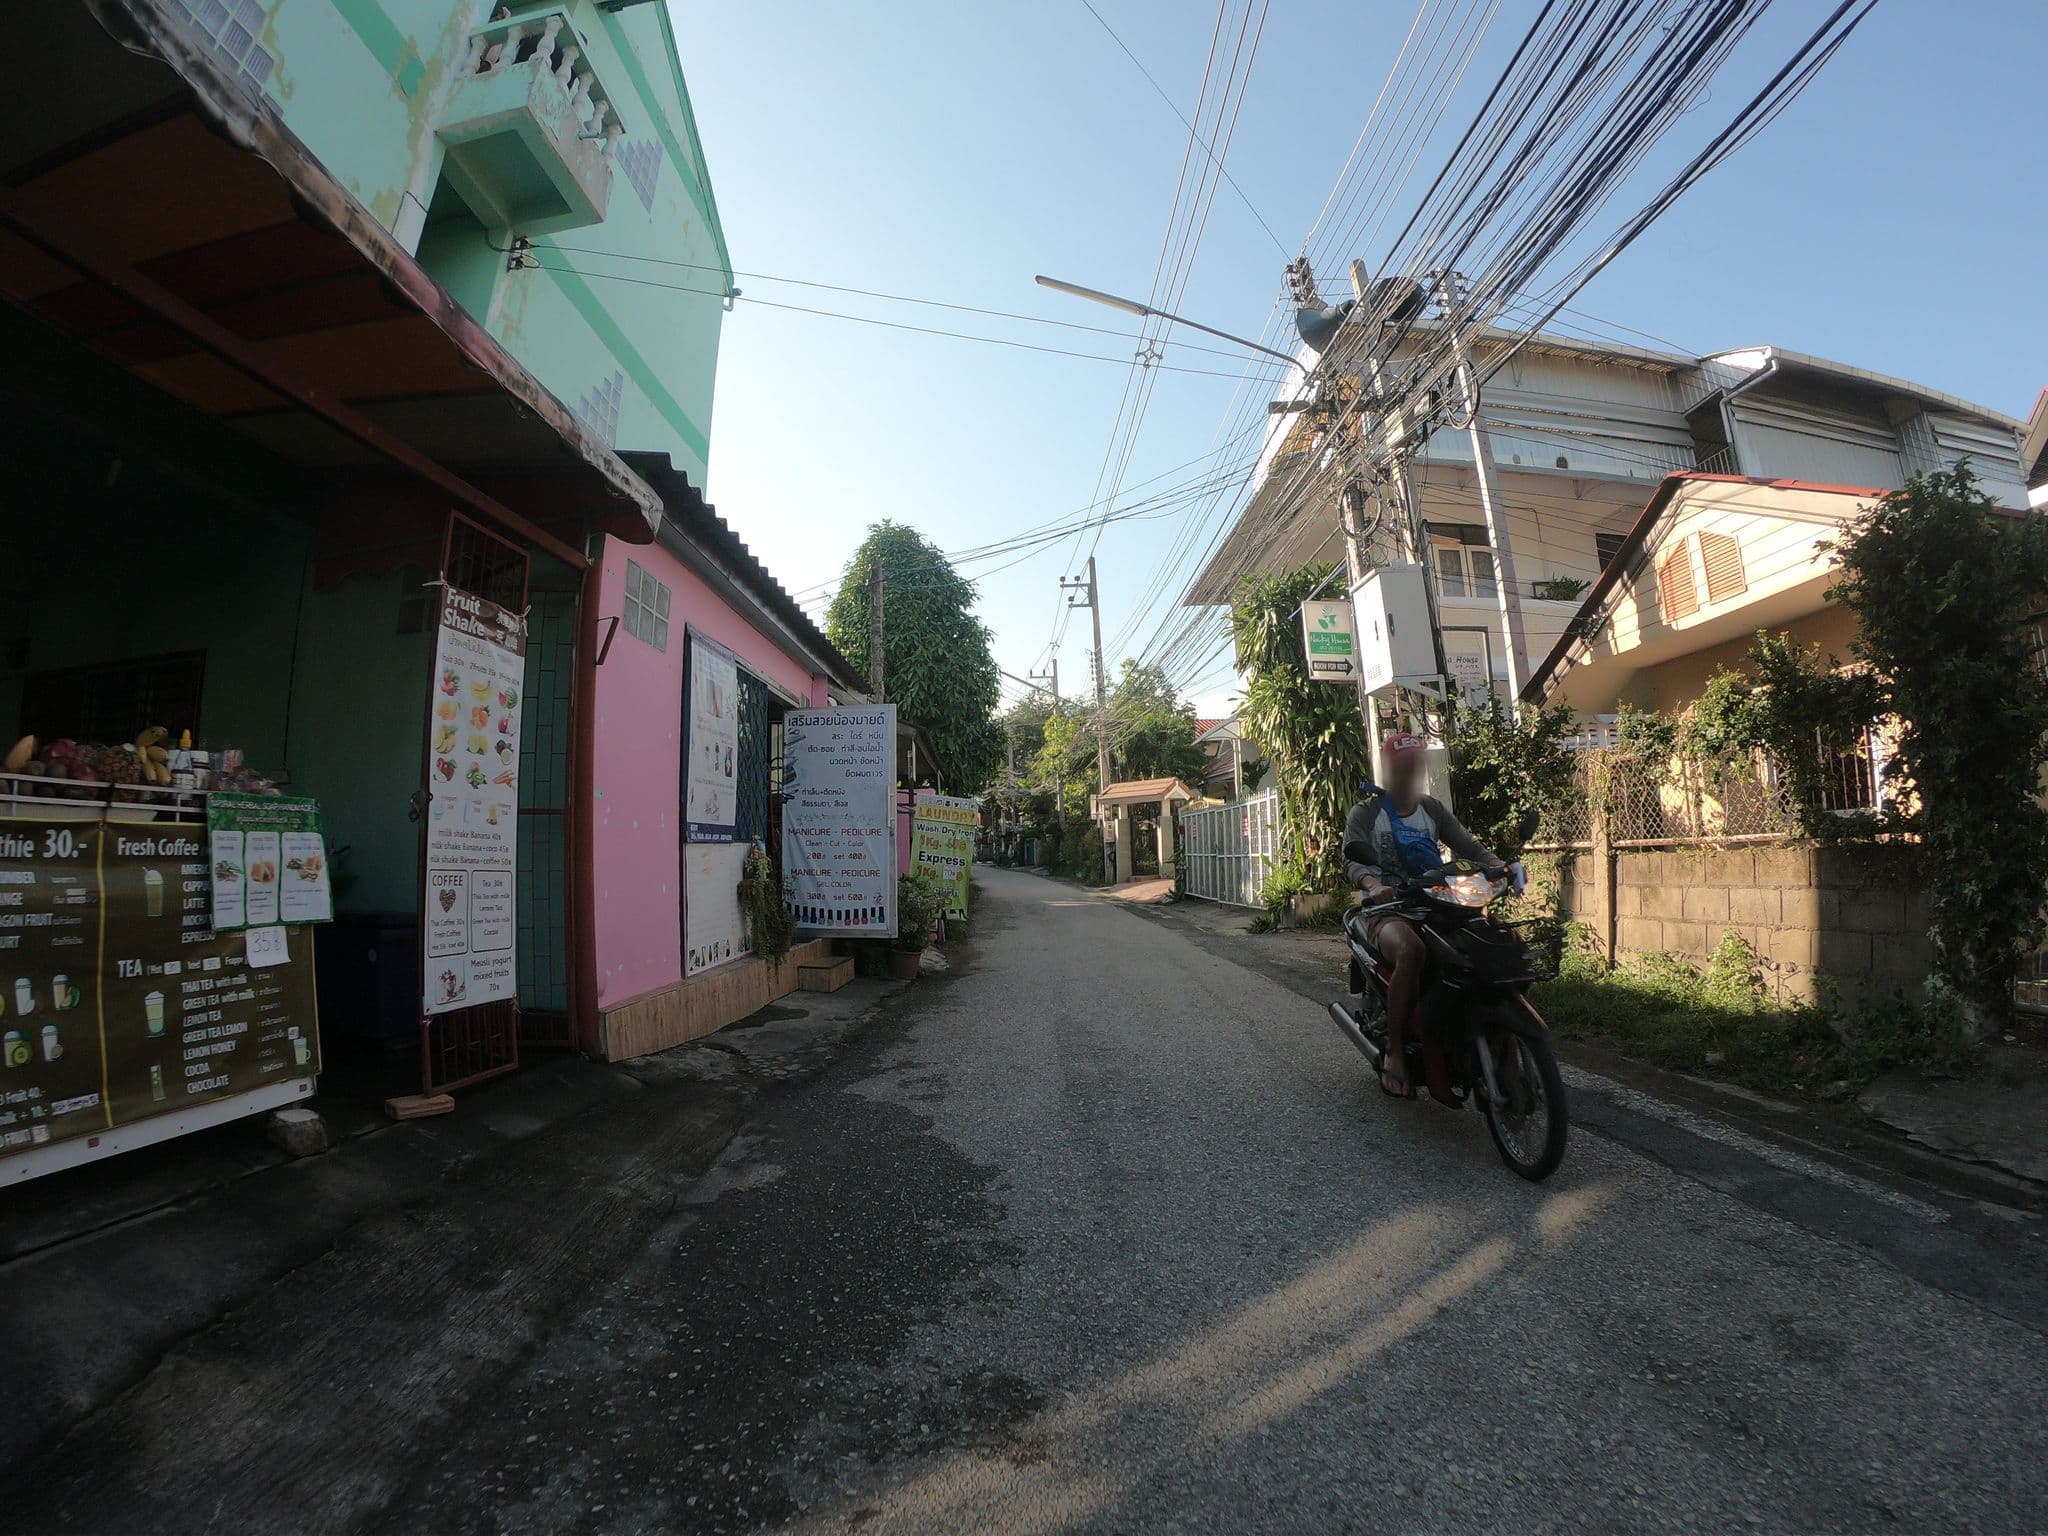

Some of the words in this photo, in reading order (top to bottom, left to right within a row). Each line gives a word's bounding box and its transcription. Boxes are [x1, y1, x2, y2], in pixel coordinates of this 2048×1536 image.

[447, 588, 481, 616] Fruit
[444, 607, 487, 637] Shake
[788, 712, 885, 727] เสริมสวยน้องมายด์
[918, 806, 976, 823] LAUNDRY
[788, 828, 831, 836] MANICURE
[841, 828, 882, 836] PEDICURE
[916, 823, 939, 834] Wash
[941, 826, 956, 839] Dry
[118, 837, 156, 856] Fresh
[158, 838, 201, 856] Coffee
[918, 850, 967, 867] Express
[432, 875, 464, 887] COFFEE
[791, 868, 832, 877] MANICURE
[841, 869, 881, 878] PEDICURE
[117, 958, 143, 979] TEA
[492, 956, 513, 968] yogurt
[181, 981, 200, 993] THAI
[200, 979, 215, 990] TEA
[183, 996, 206, 1011] GREEN
[207, 993, 220, 1006] TEA
[184, 1012, 208, 1027] LEMON
[208, 1009, 222, 1021] TEA
[183, 1028, 207, 1043] GREEN
[208, 1025, 221, 1039] TEA
[221, 1020, 248, 1036] LEMON
[184, 1045, 210, 1061] LEMON
[186, 1062, 210, 1078] COCOA
[188, 1073, 230, 1094] CHOCOLATE
